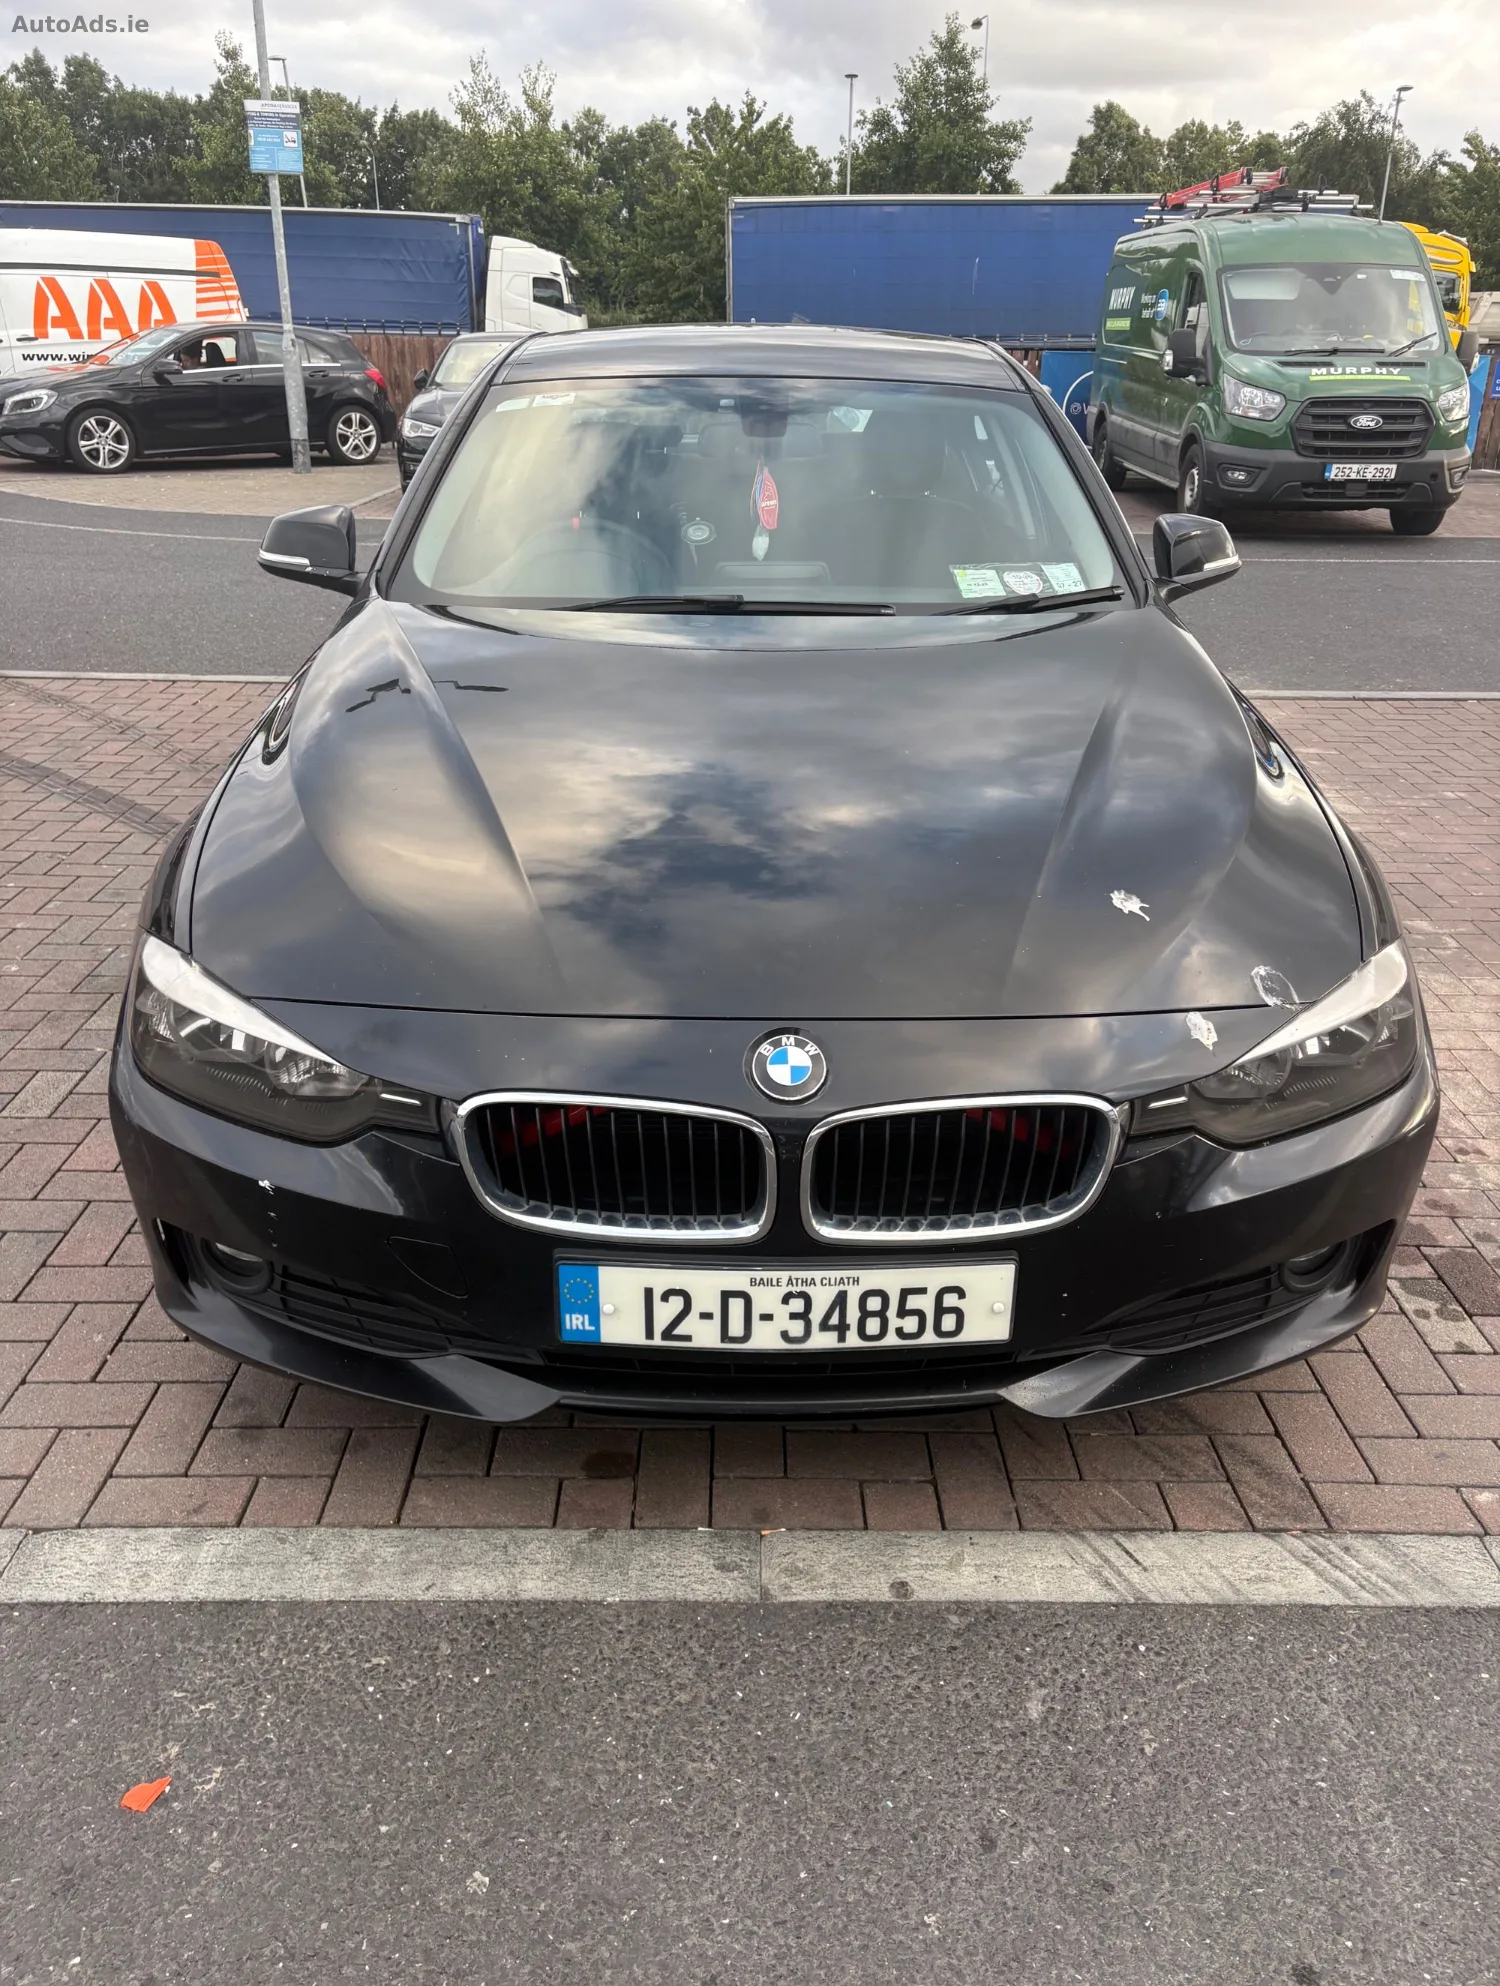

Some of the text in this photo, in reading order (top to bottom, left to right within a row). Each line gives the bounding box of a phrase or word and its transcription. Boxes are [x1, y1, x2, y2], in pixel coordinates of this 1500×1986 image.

[1109, 286, 1136, 310] MURPHY
[33, 276, 178, 340] AAA
[1311, 367, 1401, 375] MURPHY
[1356, 417, 1378, 426] Ford
[1334, 467, 1393, 478] 252-KE-2921
[760, 1036, 819, 1056] BMW
[750, 1277, 782, 1287] BAILE
[820, 1276, 860, 1287] CLIATH
[565, 1313, 595, 1331] IRL
[644, 1286, 966, 1345] 12-D-34856
